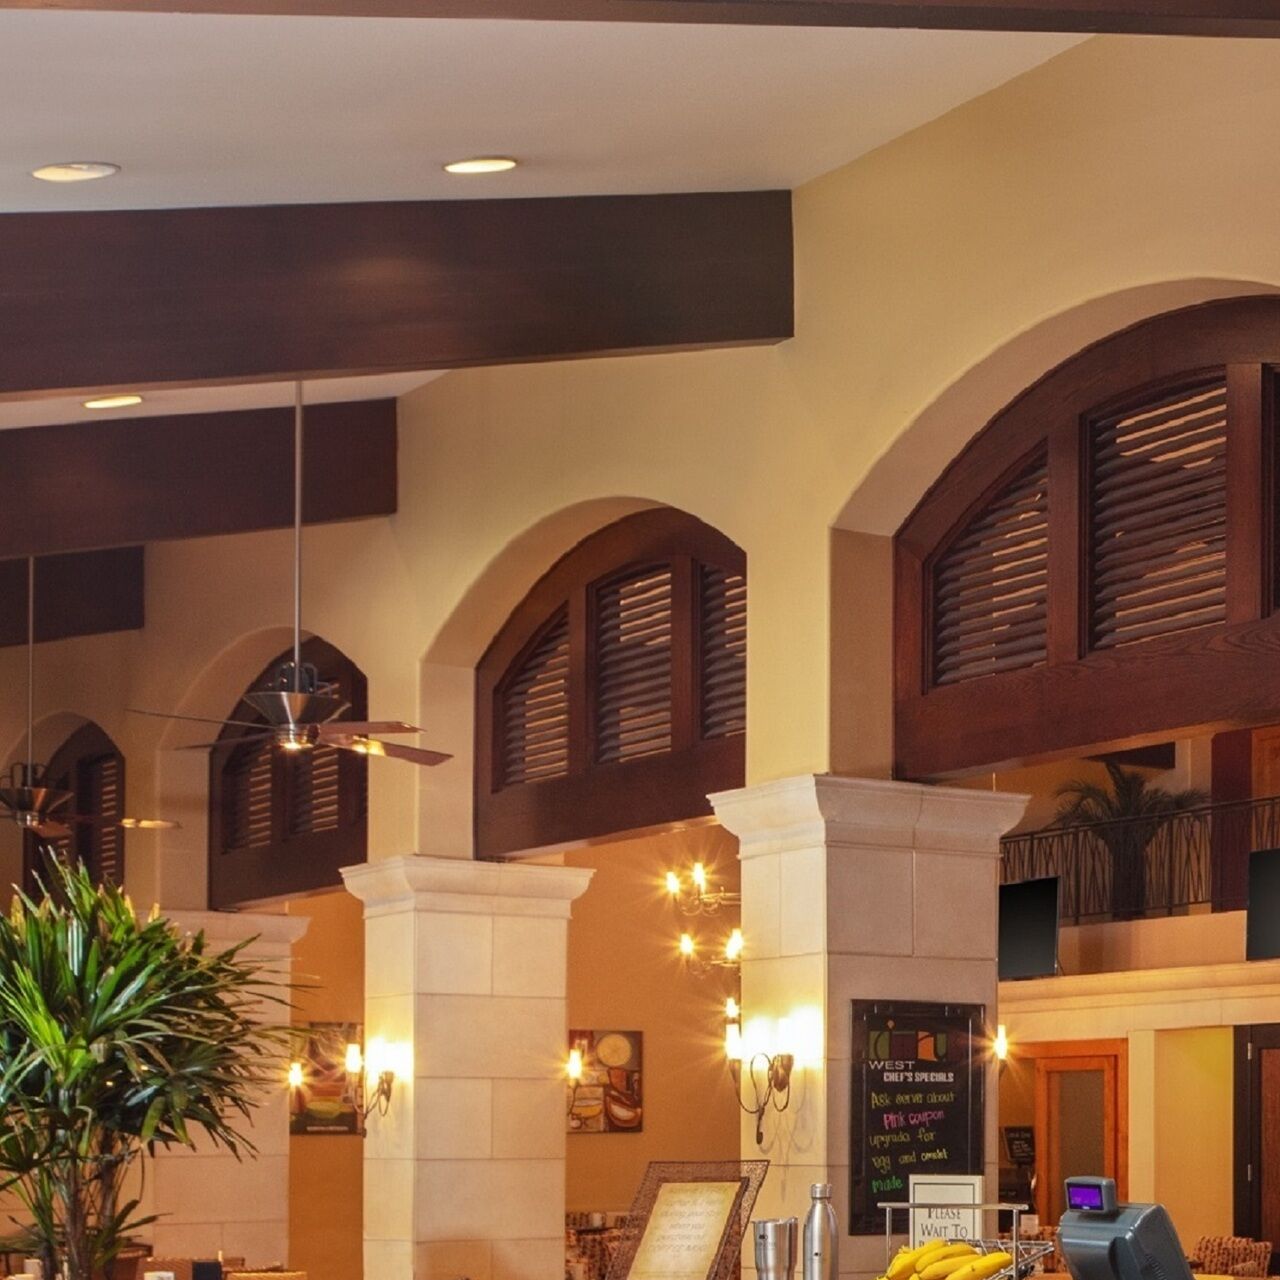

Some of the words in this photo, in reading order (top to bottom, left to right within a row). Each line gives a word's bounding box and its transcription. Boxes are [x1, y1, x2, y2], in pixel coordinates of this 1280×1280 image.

[868, 1061, 915, 1070] WEST
[883, 1072, 913, 1082] CHEF'S
[914, 1072, 954, 1082] SPECIALS
[928, 1208, 961, 1219] PLEASE
[921, 1223, 948, 1237] WAIT
[952, 1224, 968, 1238] TO
